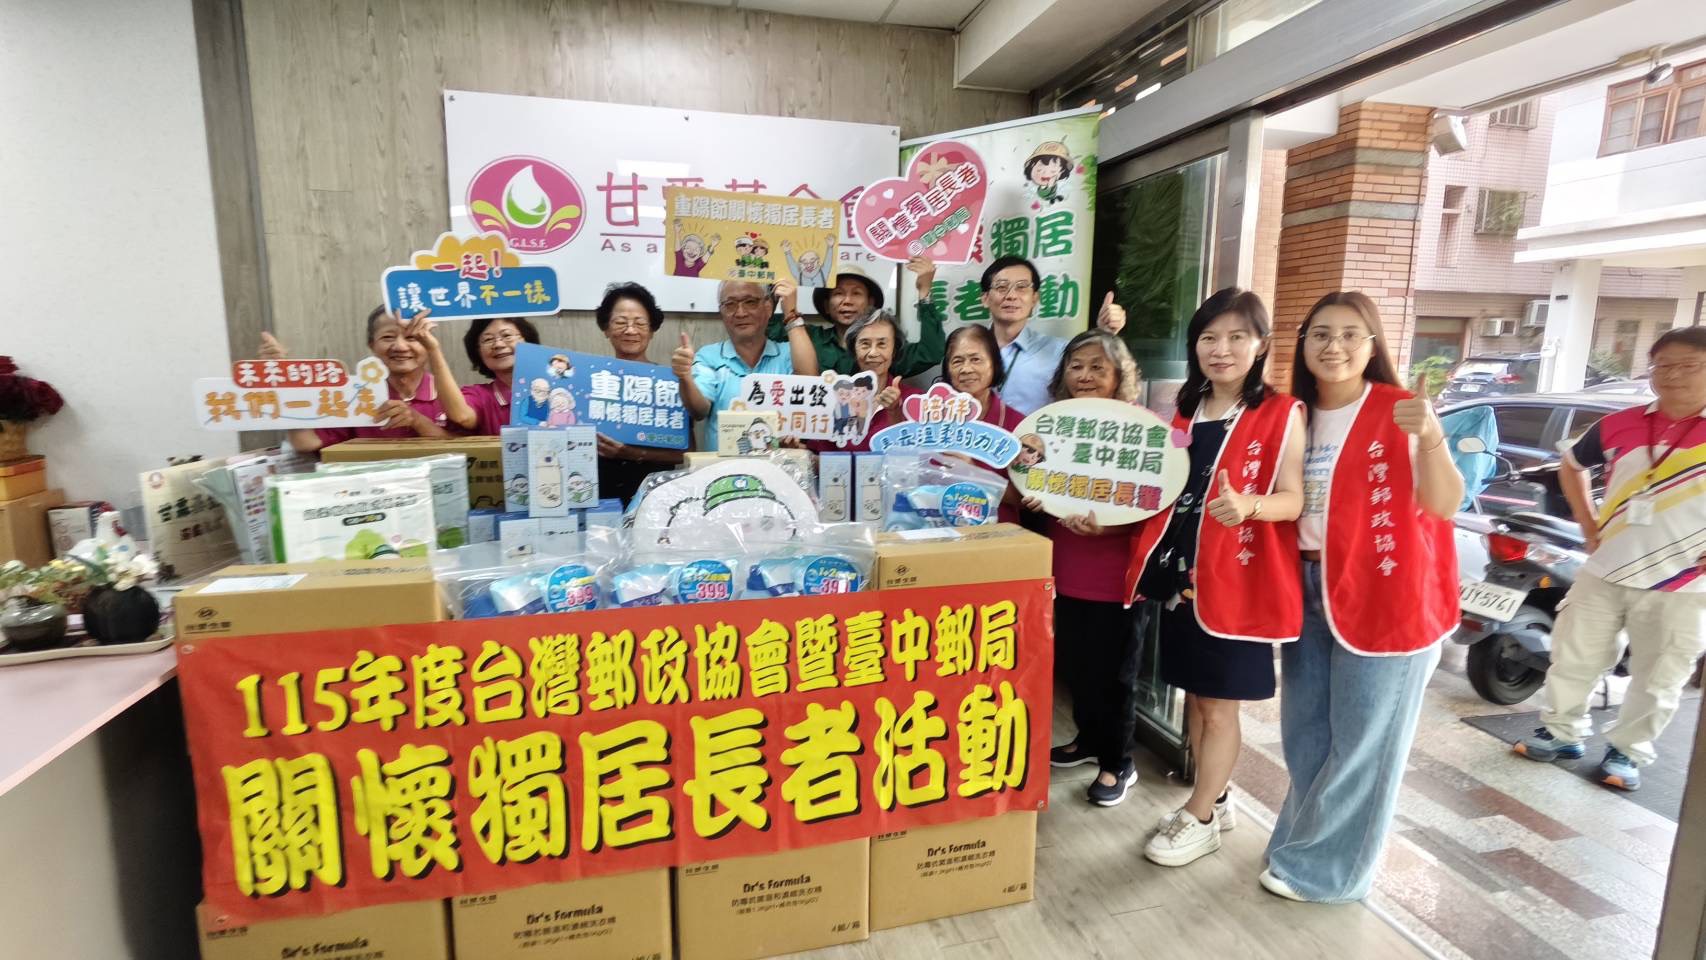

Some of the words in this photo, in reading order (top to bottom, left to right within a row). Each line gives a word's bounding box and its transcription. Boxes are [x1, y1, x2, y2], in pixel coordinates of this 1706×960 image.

[674, 194, 834, 229] 重陽節關懷獨居長者
[601, 238, 632, 253] As
[397, 280, 551, 312] 讓世界不一樣
[590, 370, 683, 407] 重陽節
[747, 380, 829, 407] 為愛出發
[922, 394, 971, 424] 陪伴
[1036, 414, 1169, 448] 台灣郵政協會
[1071, 442, 1164, 475] 臺中郵局
[1235, 440, 1262, 566] 台灣郵協會
[1367, 440, 1398, 576] 台灣郵政協會
[236, 600, 1017, 738] 115年度台灣郵政協會暨臺中郵局
[221, 680, 1030, 898] 關懷獨居長者活動
[927, 846, 947, 858] Dr's
[948, 839, 987, 854] Formula
[743, 880, 765, 893] Dr's
[767, 874, 811, 890] Formula
[526, 912, 551, 925] Dr's
[553, 904, 604, 921] Formula
